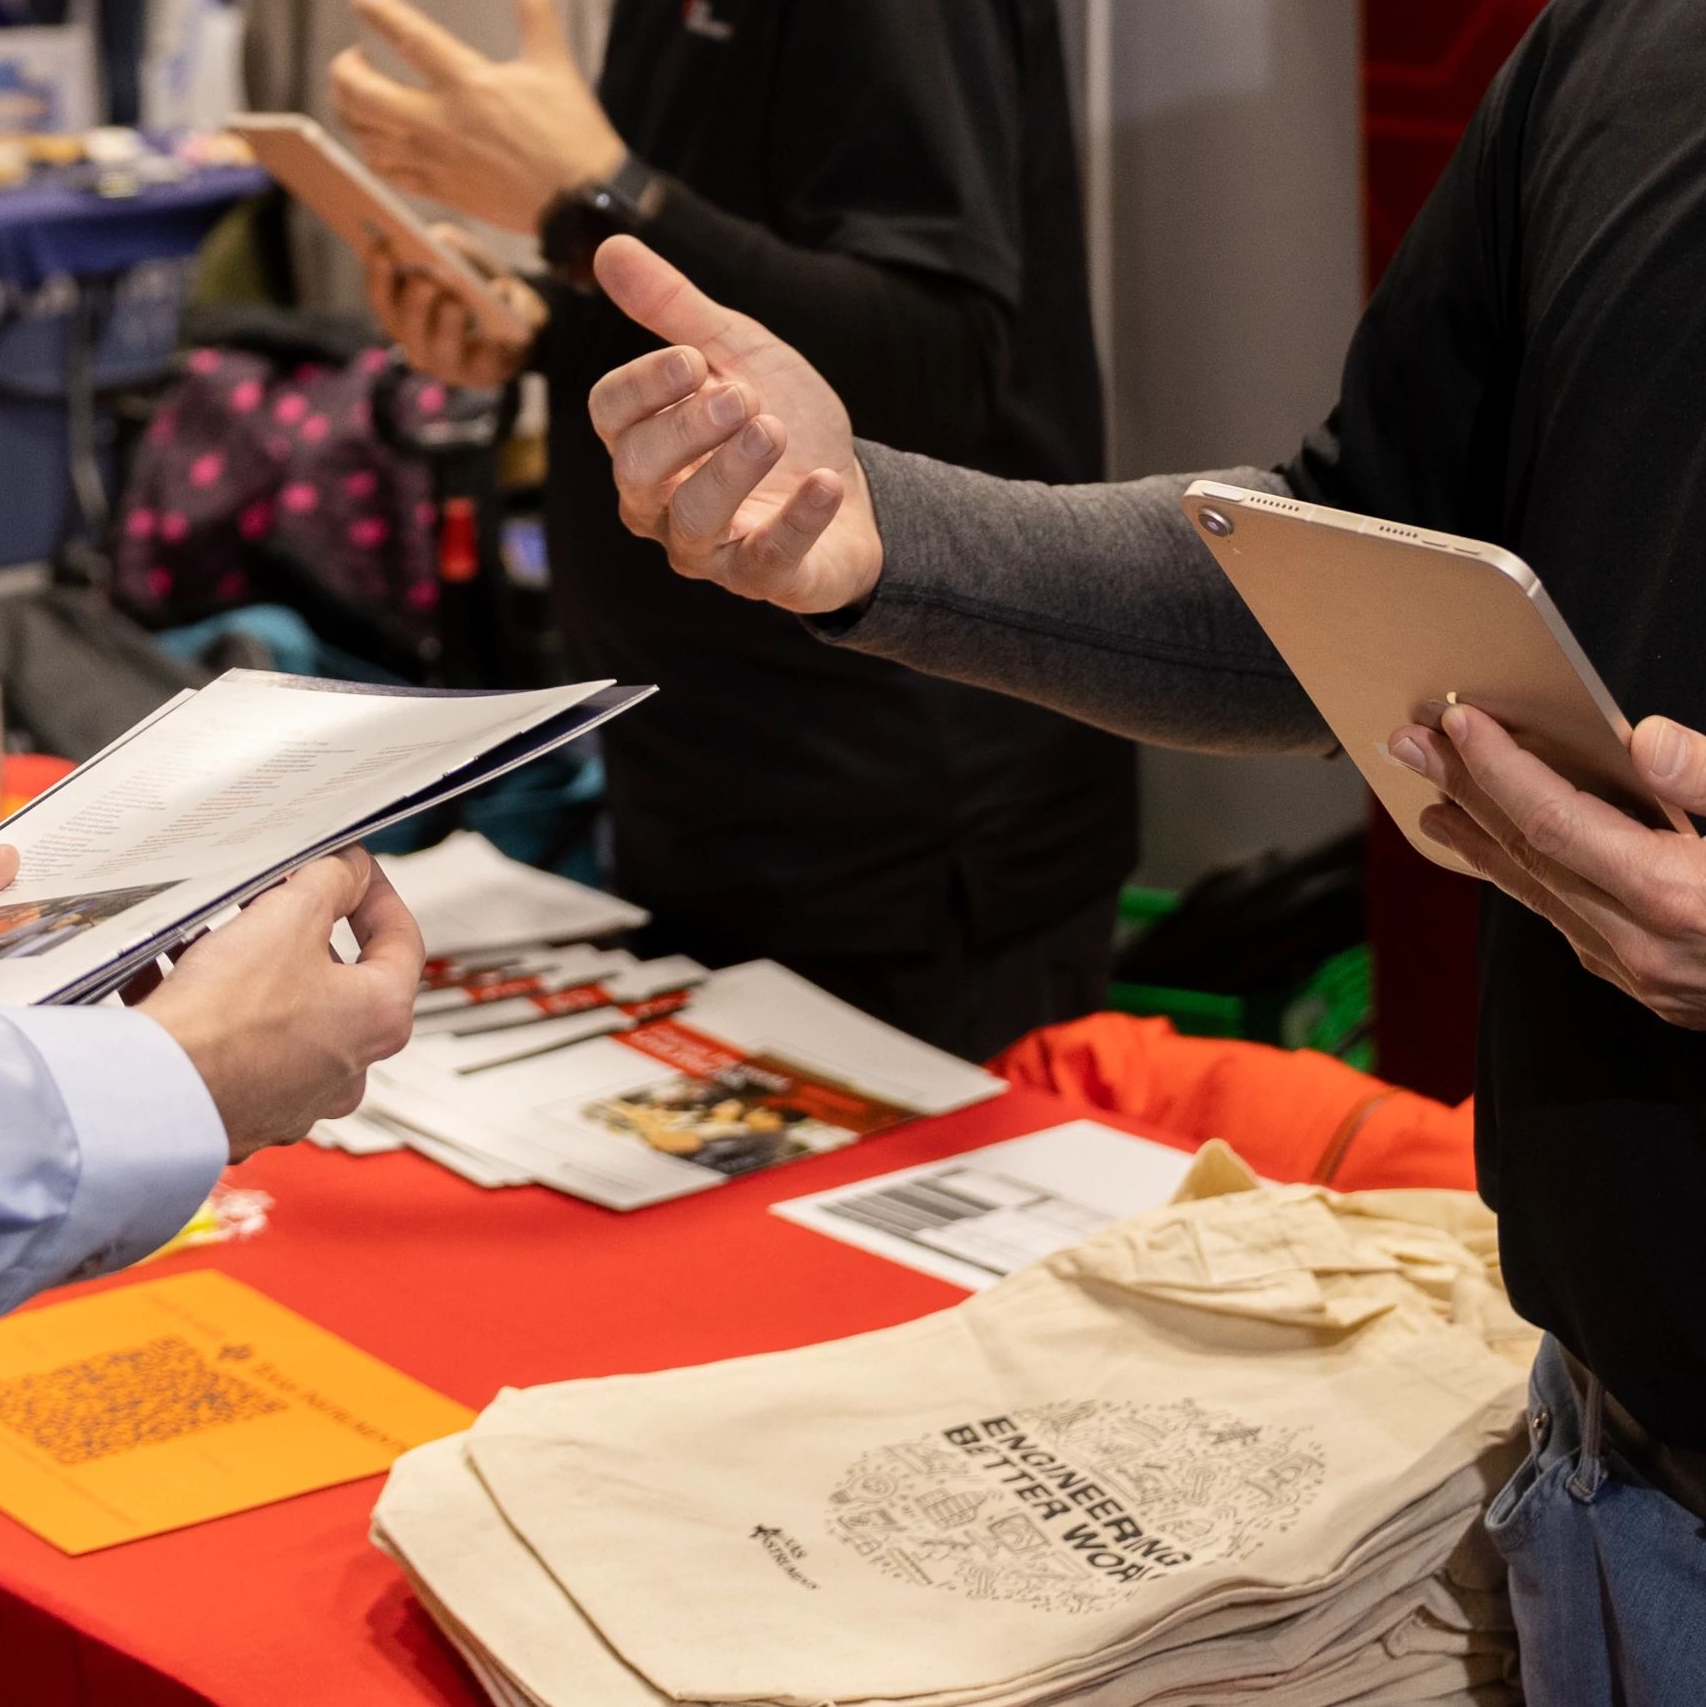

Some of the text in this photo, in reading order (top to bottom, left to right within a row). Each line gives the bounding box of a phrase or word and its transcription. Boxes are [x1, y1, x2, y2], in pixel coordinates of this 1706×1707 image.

[943, 1424, 1166, 1583] BETTER WOR
[981, 1415, 1192, 1567] ENGINEERING
